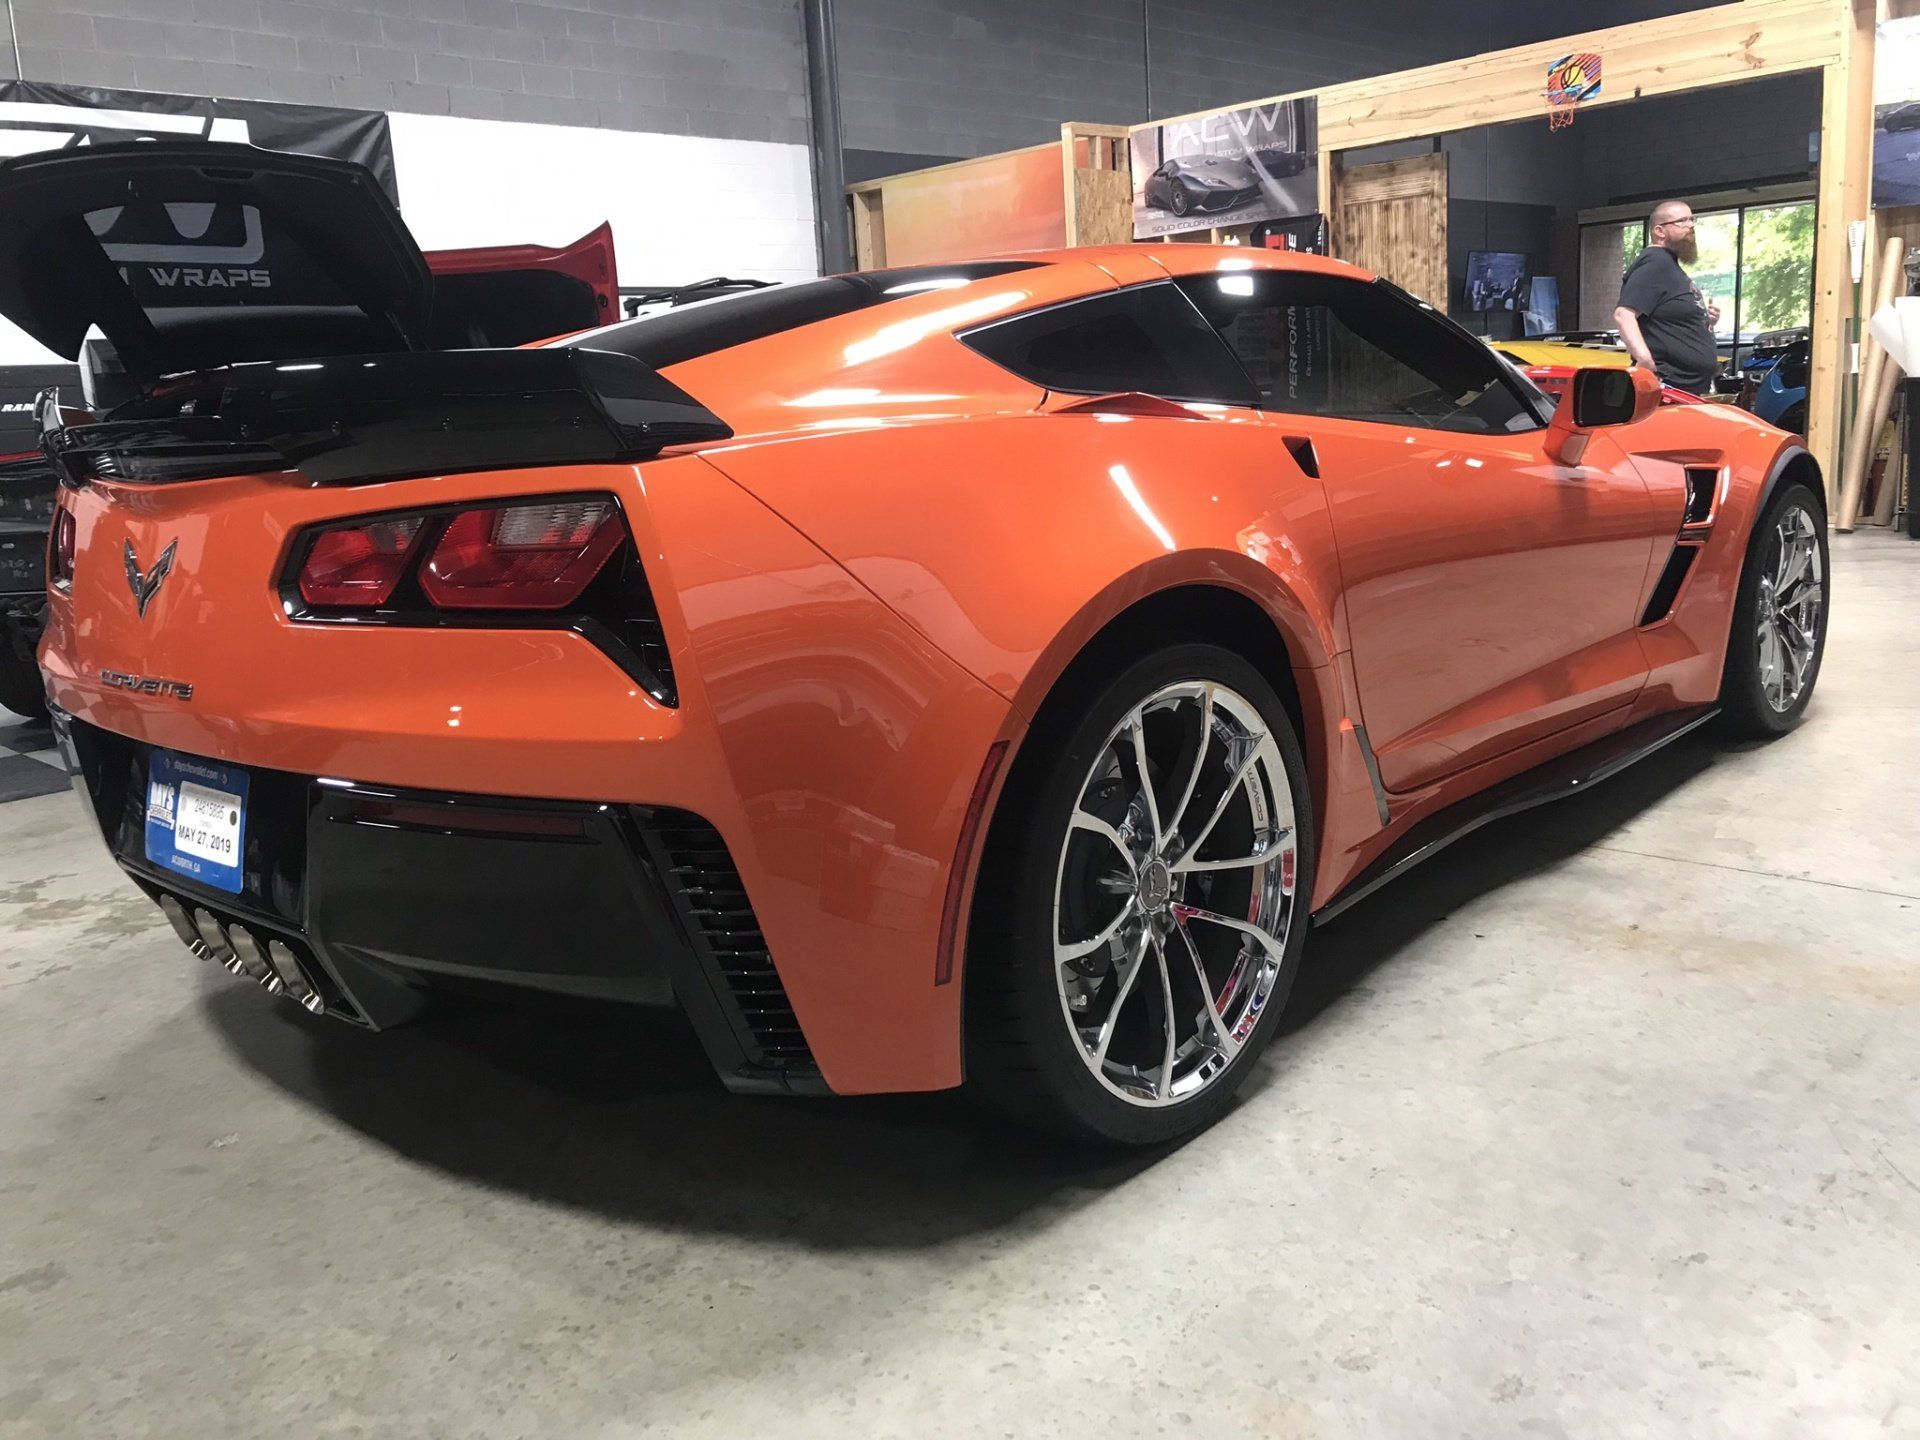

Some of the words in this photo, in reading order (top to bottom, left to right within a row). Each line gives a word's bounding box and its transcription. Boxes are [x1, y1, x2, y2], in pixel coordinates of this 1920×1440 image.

[1170, 103, 1282, 151] ACW
[1178, 219, 1205, 230] COLOR
[1207, 214, 1244, 226] CHANGE
[147, 267, 272, 288] WRAPS
[178, 824, 197, 843] MAY
[210, 834, 231, 853] 2019
